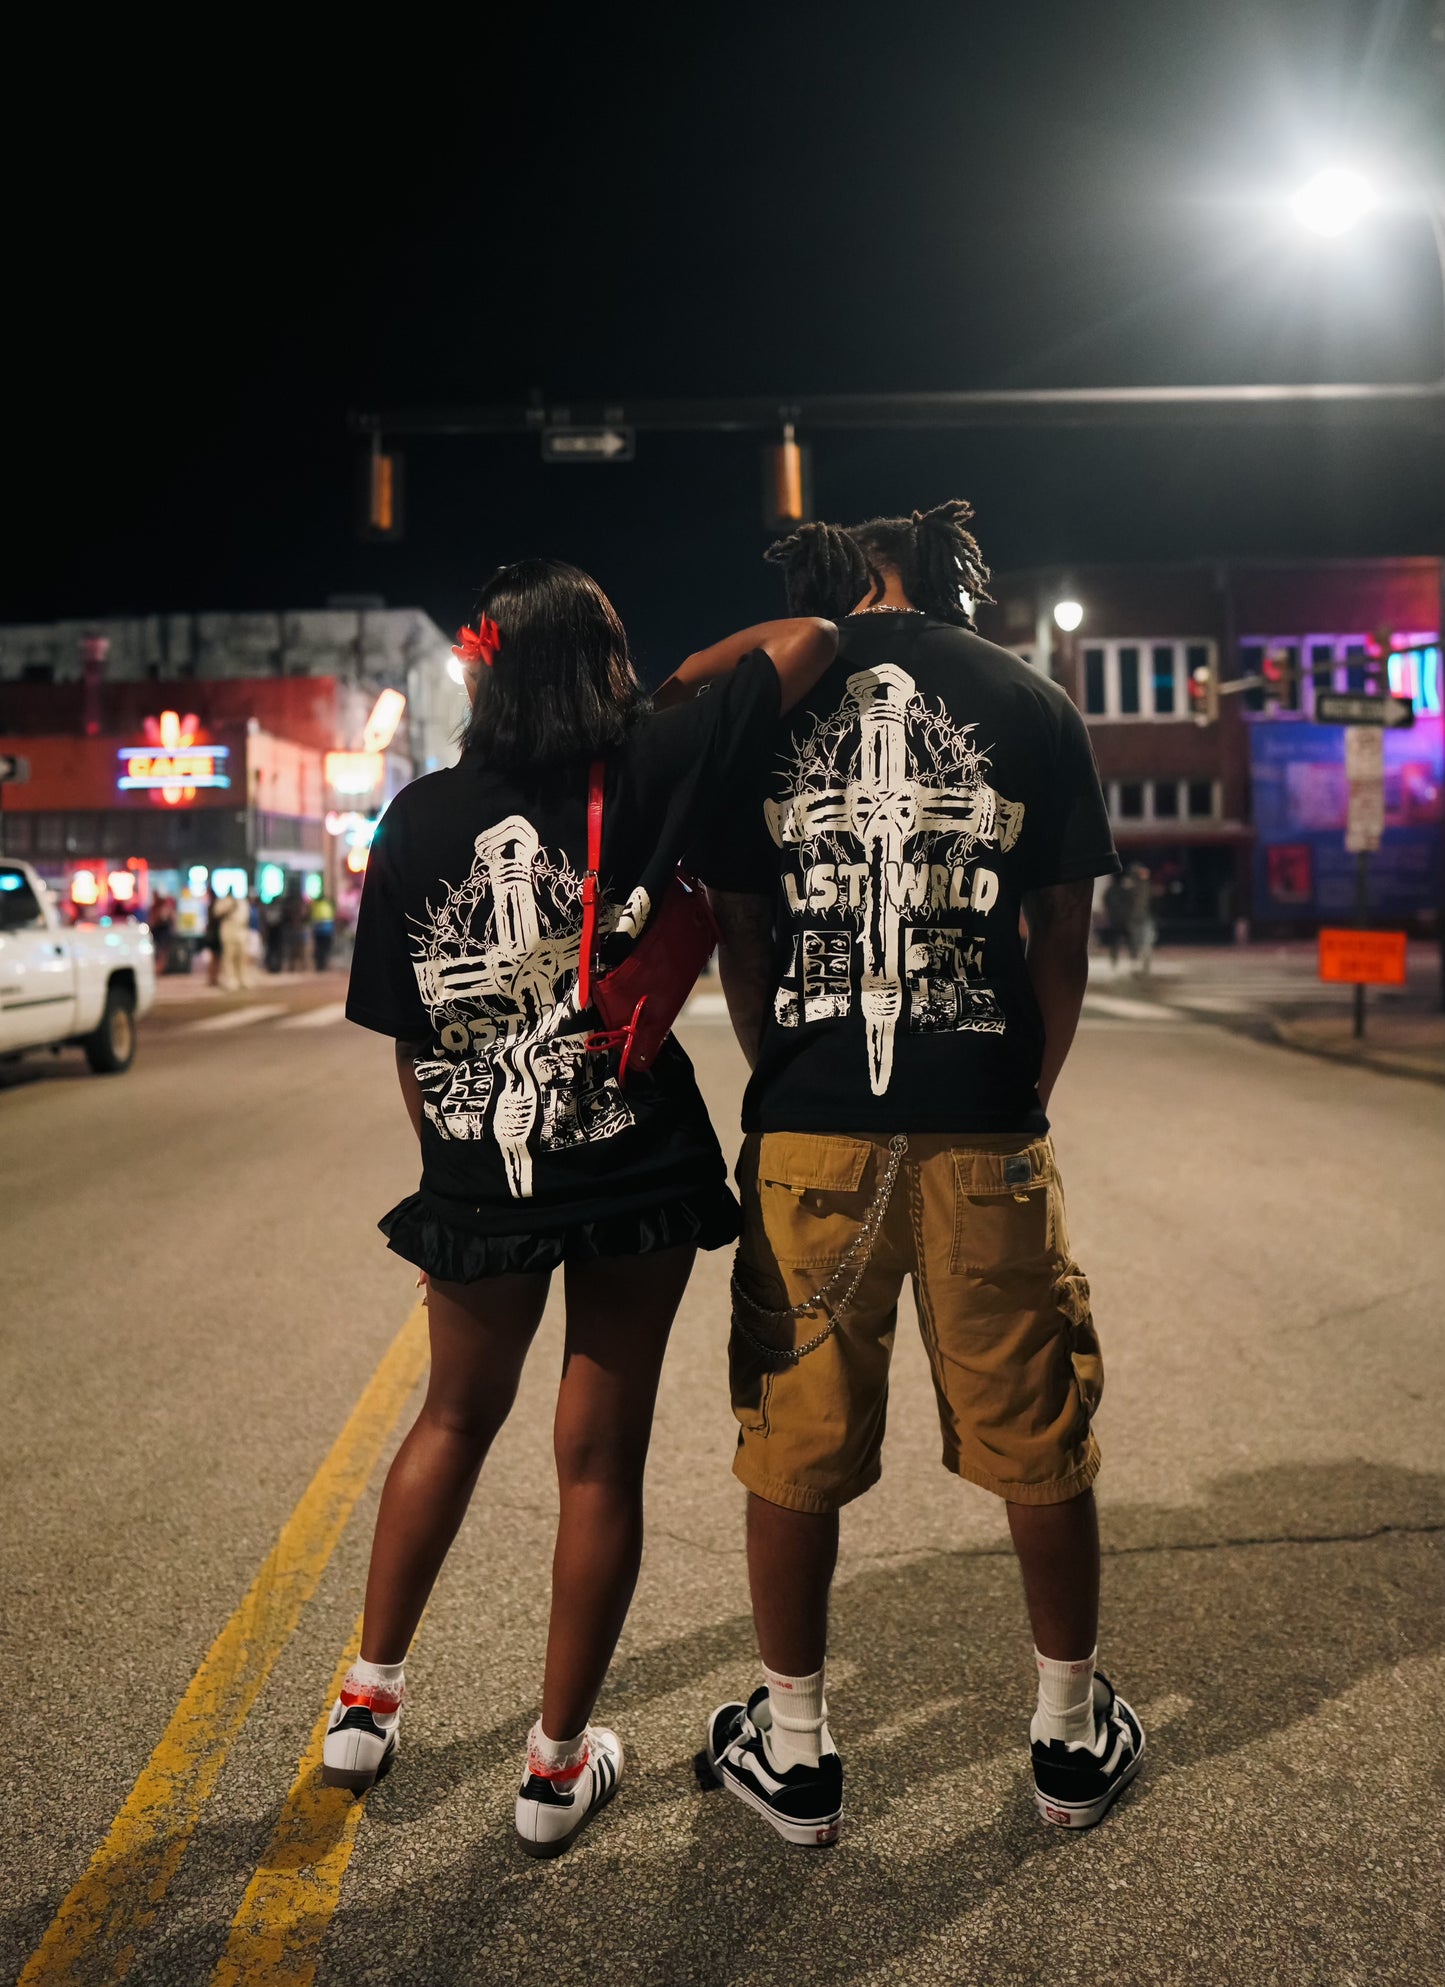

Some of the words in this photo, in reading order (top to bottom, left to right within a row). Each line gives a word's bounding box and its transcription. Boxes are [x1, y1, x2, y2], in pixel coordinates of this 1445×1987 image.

[782, 863, 870, 915] LST
[884, 862, 1000, 917] WRLD
[957, 1018, 1006, 1035] 2024
